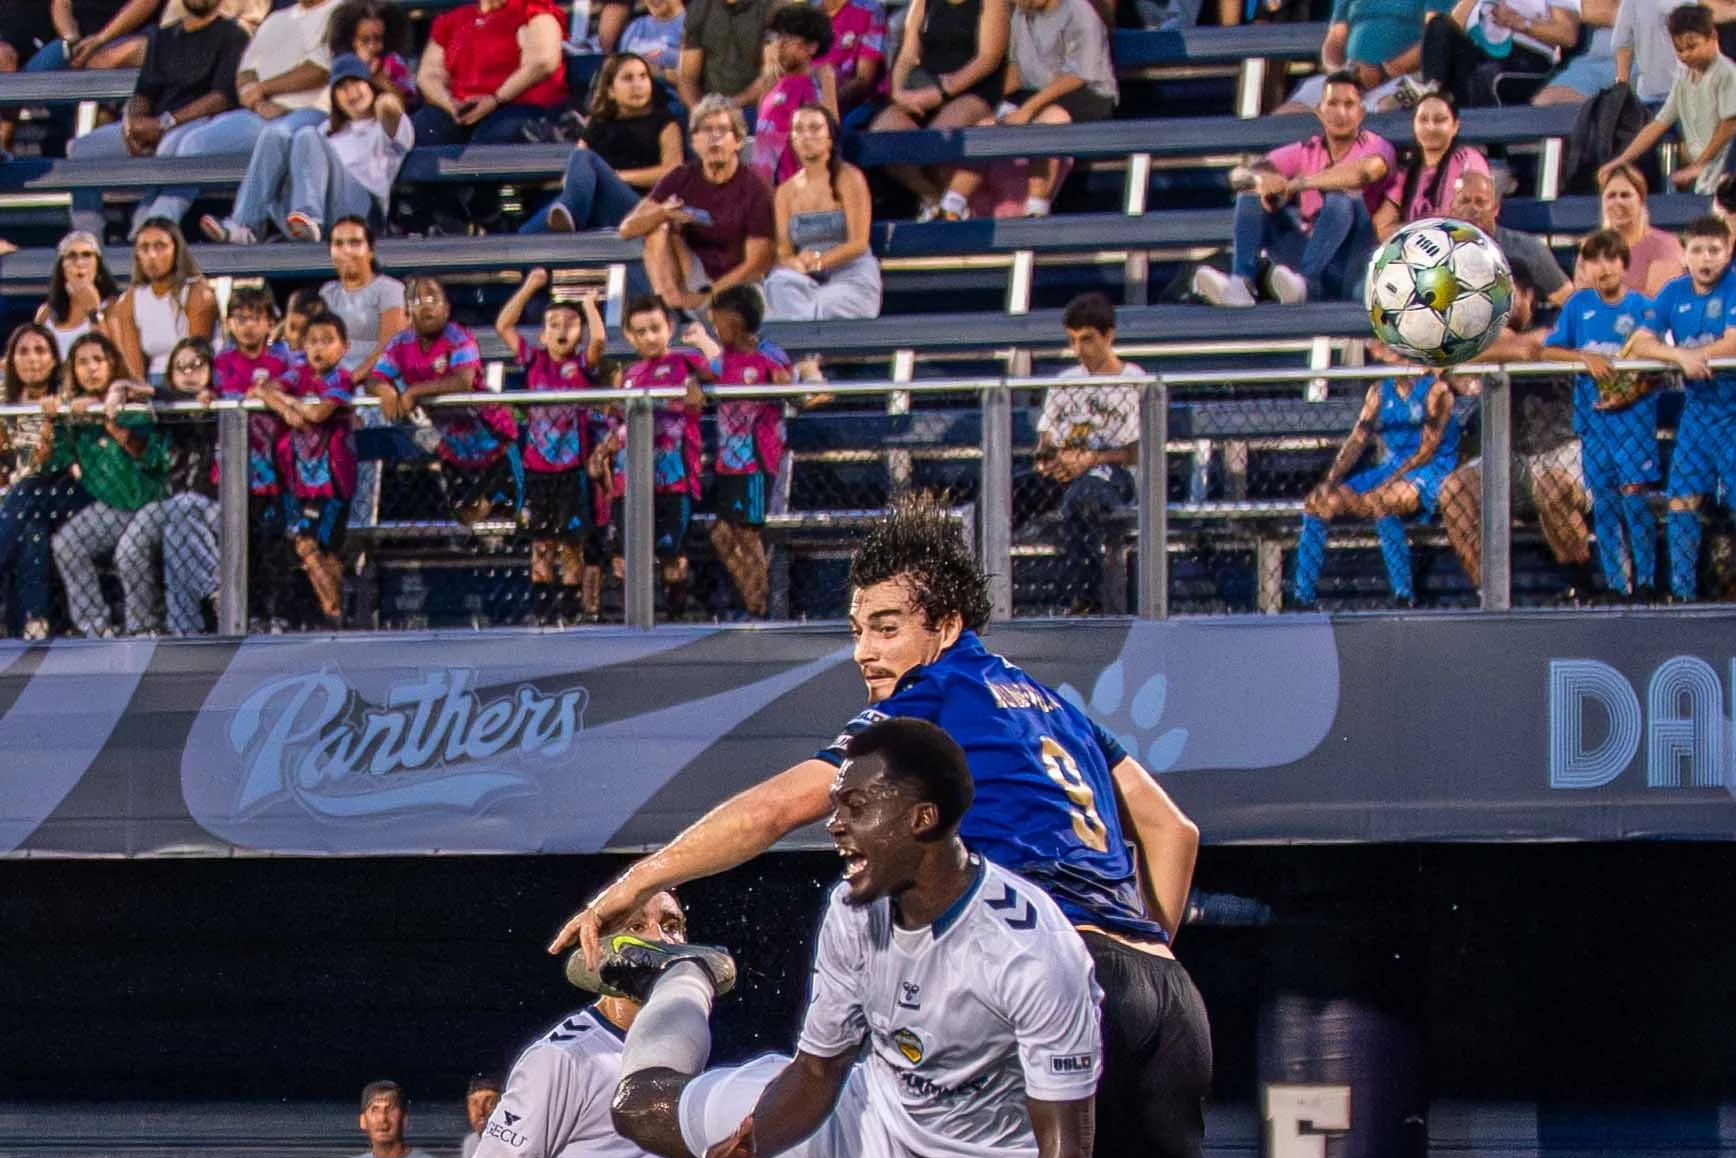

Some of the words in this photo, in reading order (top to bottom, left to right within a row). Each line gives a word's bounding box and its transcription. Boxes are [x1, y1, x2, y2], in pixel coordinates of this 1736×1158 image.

[230, 665, 582, 815] Panthers
[1550, 655, 1736, 789] DA
[1040, 735, 1108, 854] 9
